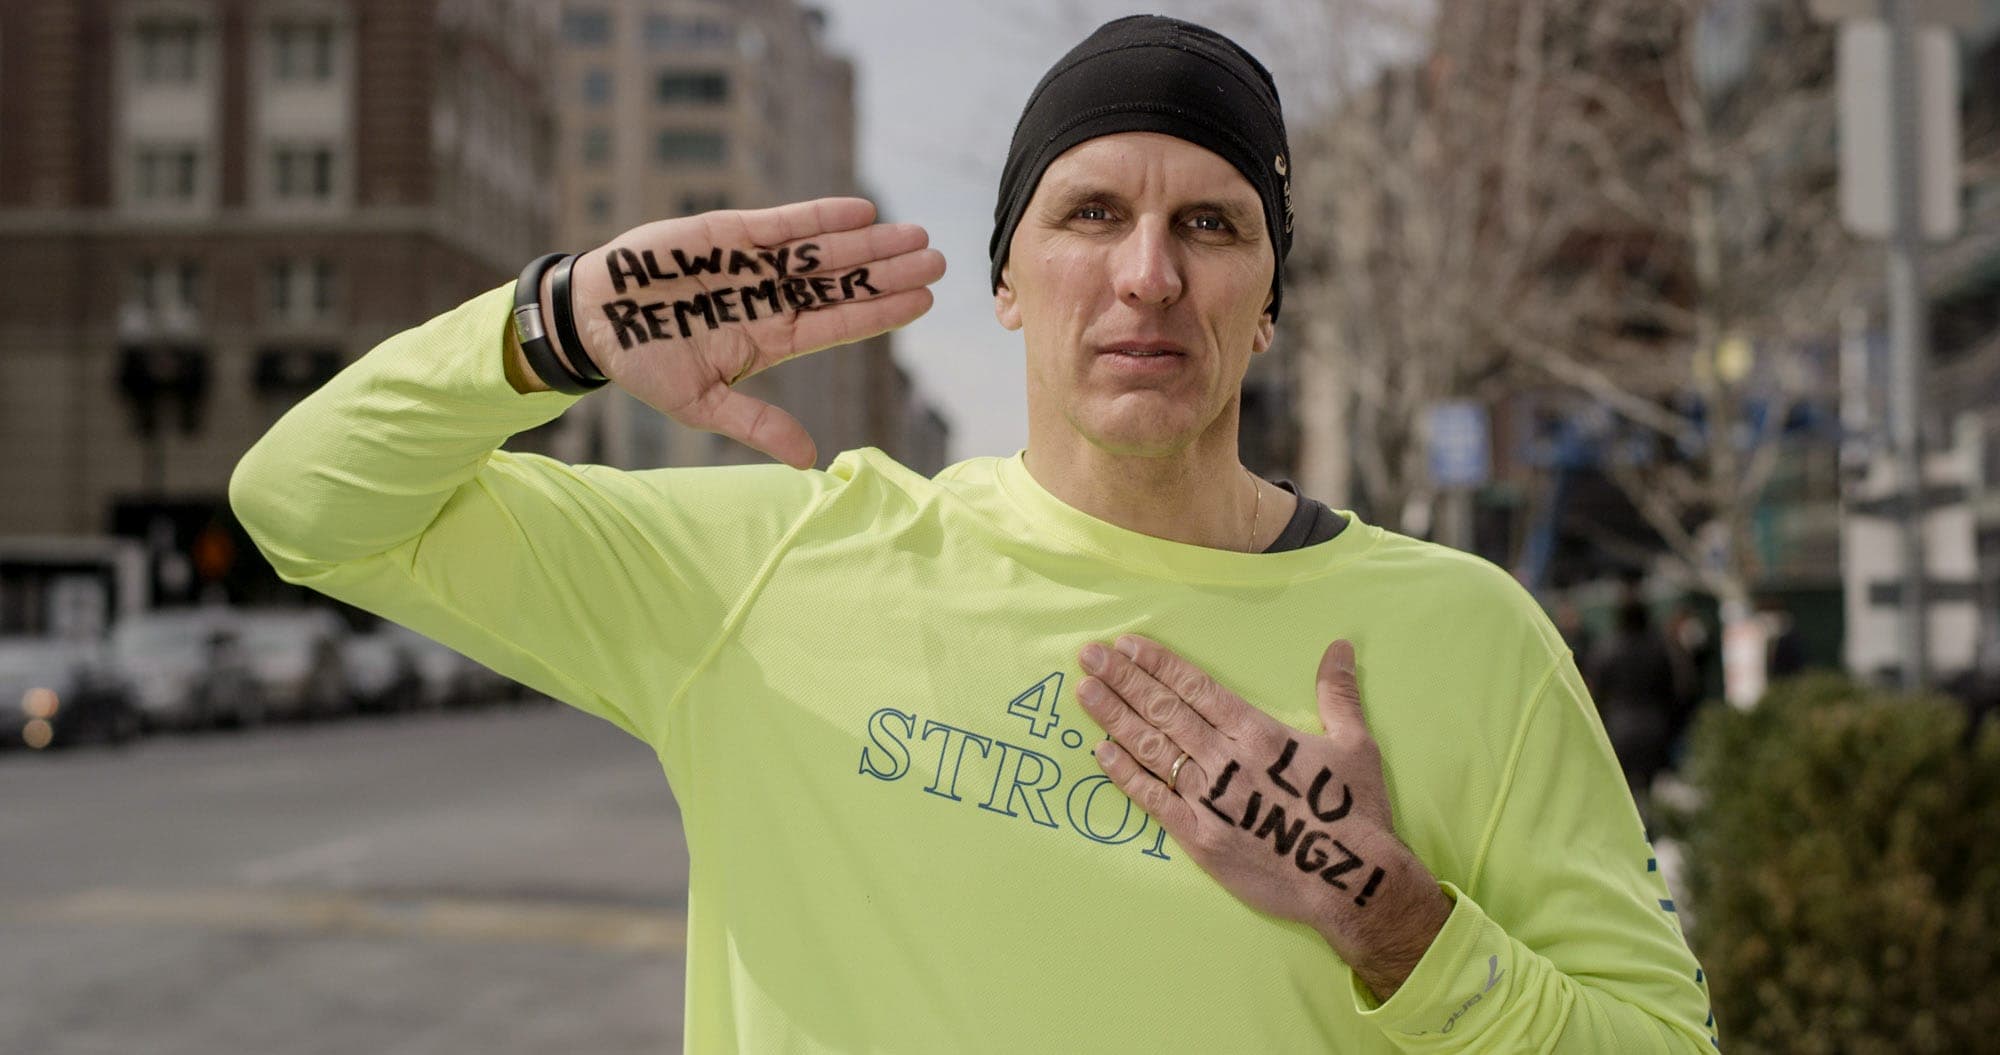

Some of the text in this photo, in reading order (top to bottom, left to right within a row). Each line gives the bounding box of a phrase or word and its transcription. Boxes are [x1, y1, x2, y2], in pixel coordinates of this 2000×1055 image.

[602, 267, 880, 351] REMEMBER
[606, 243, 821, 295] ALWAYS
[1007, 671, 1112, 758] 4.
[1266, 738, 1353, 823] LU
